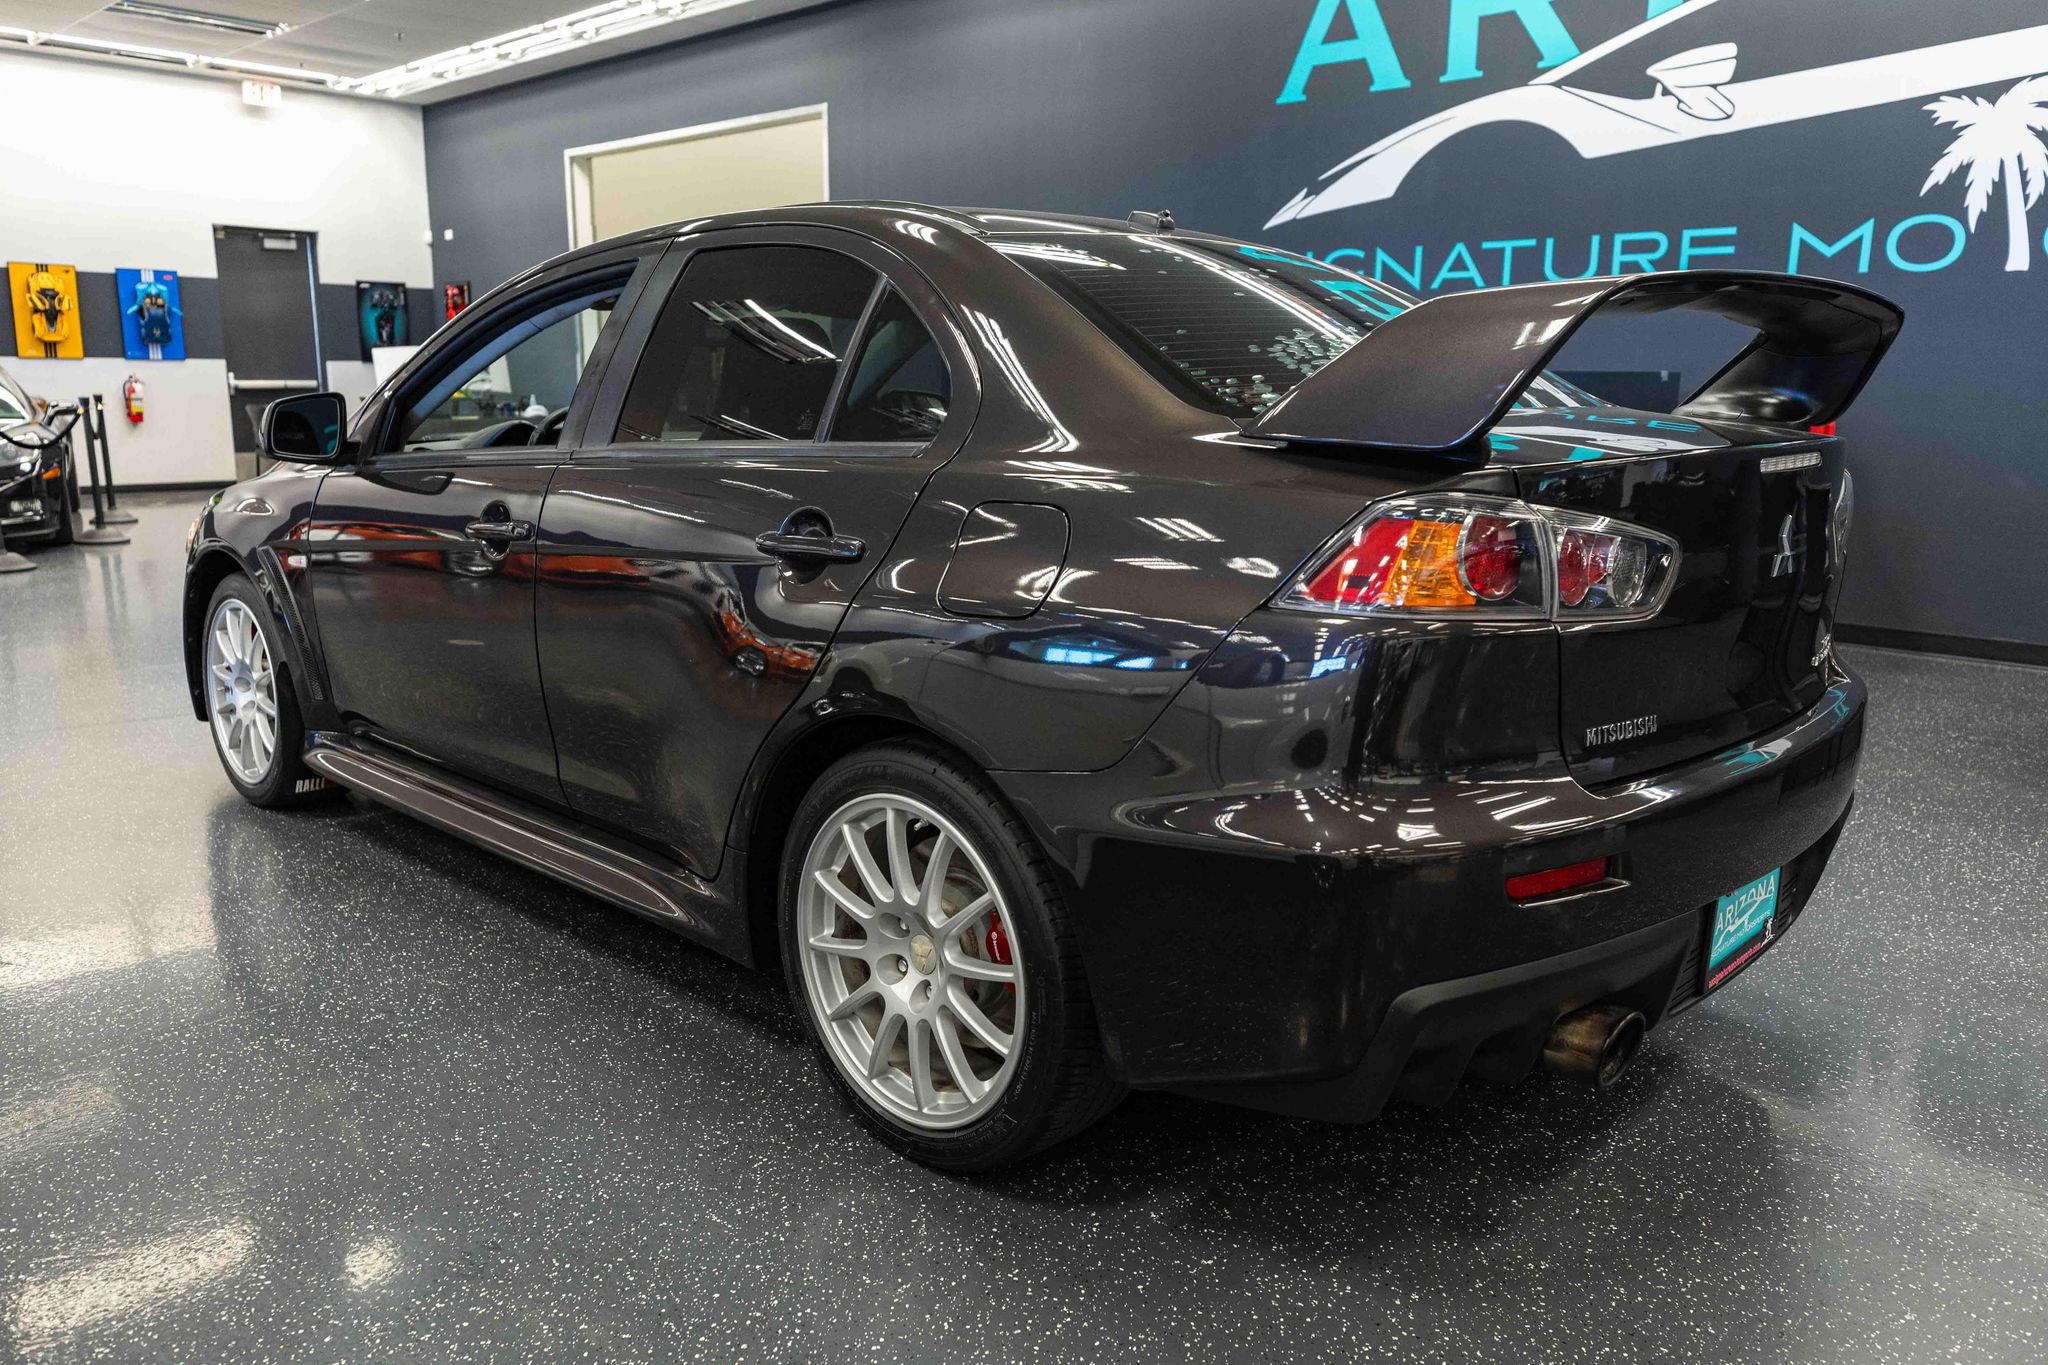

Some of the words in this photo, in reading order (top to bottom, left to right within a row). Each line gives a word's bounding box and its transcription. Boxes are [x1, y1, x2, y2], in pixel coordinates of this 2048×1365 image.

[1276, 0, 1684, 104] AR
[1586, 715, 1657, 747] MITSUBISHI
[295, 777, 326, 793] RALLI
[1715, 875, 1775, 934] ARIZONA
